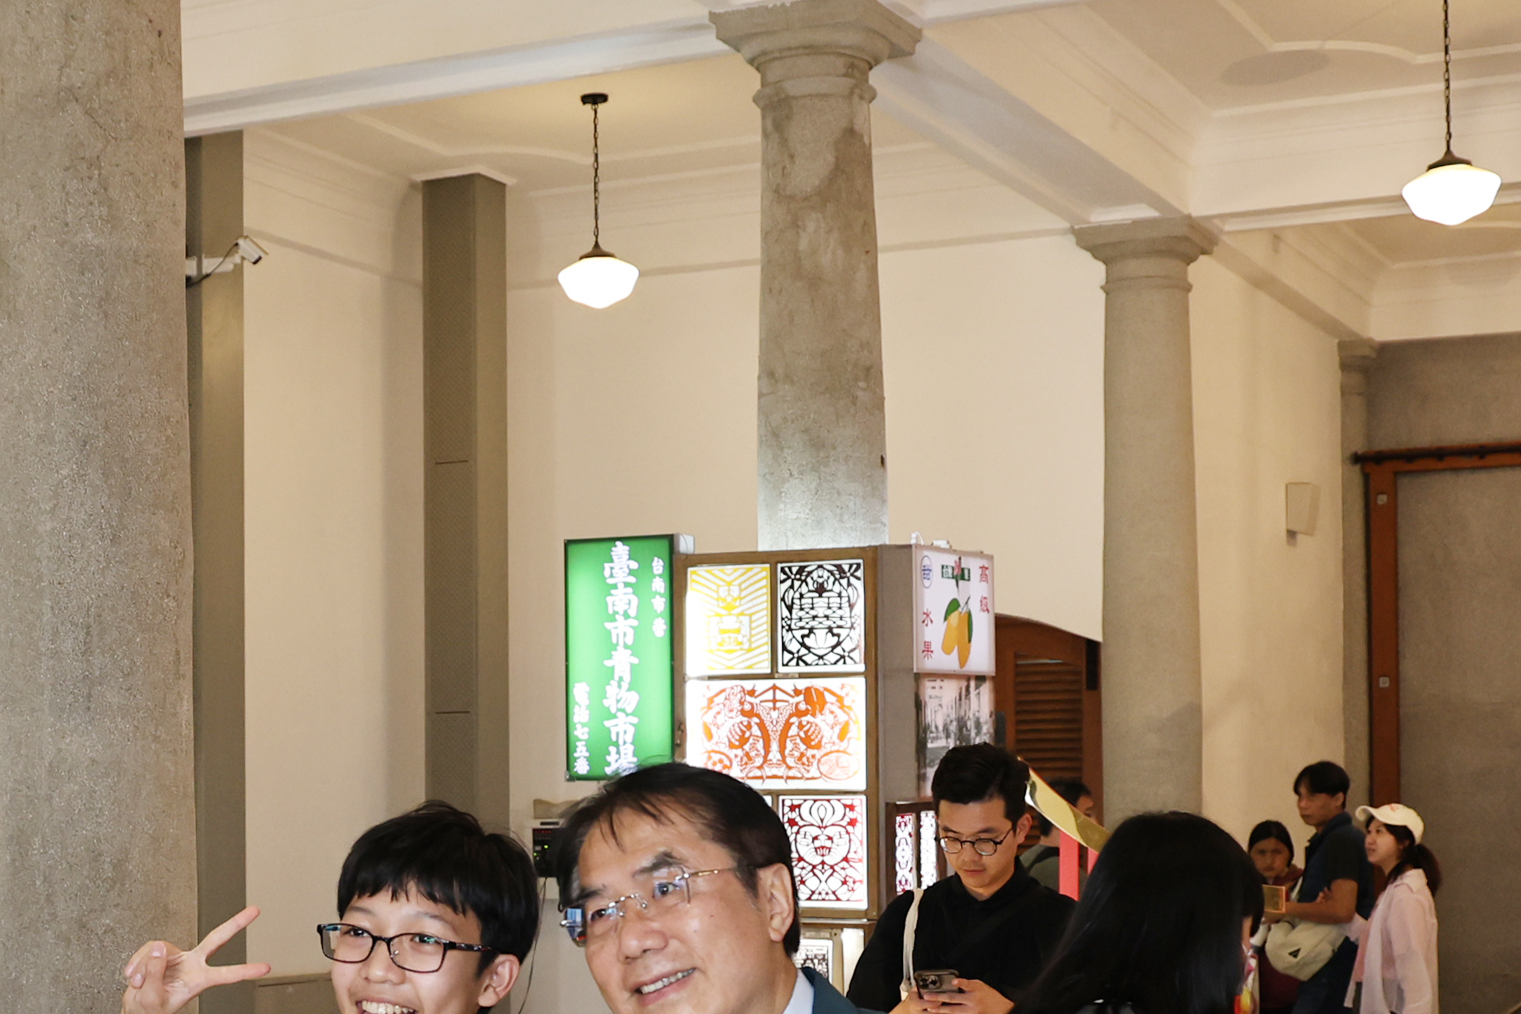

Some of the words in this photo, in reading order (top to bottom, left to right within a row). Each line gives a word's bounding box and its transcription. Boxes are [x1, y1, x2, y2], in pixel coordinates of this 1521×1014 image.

[603, 541, 640, 777] 臺南市青物市場
[921, 608, 934, 661] 水果
